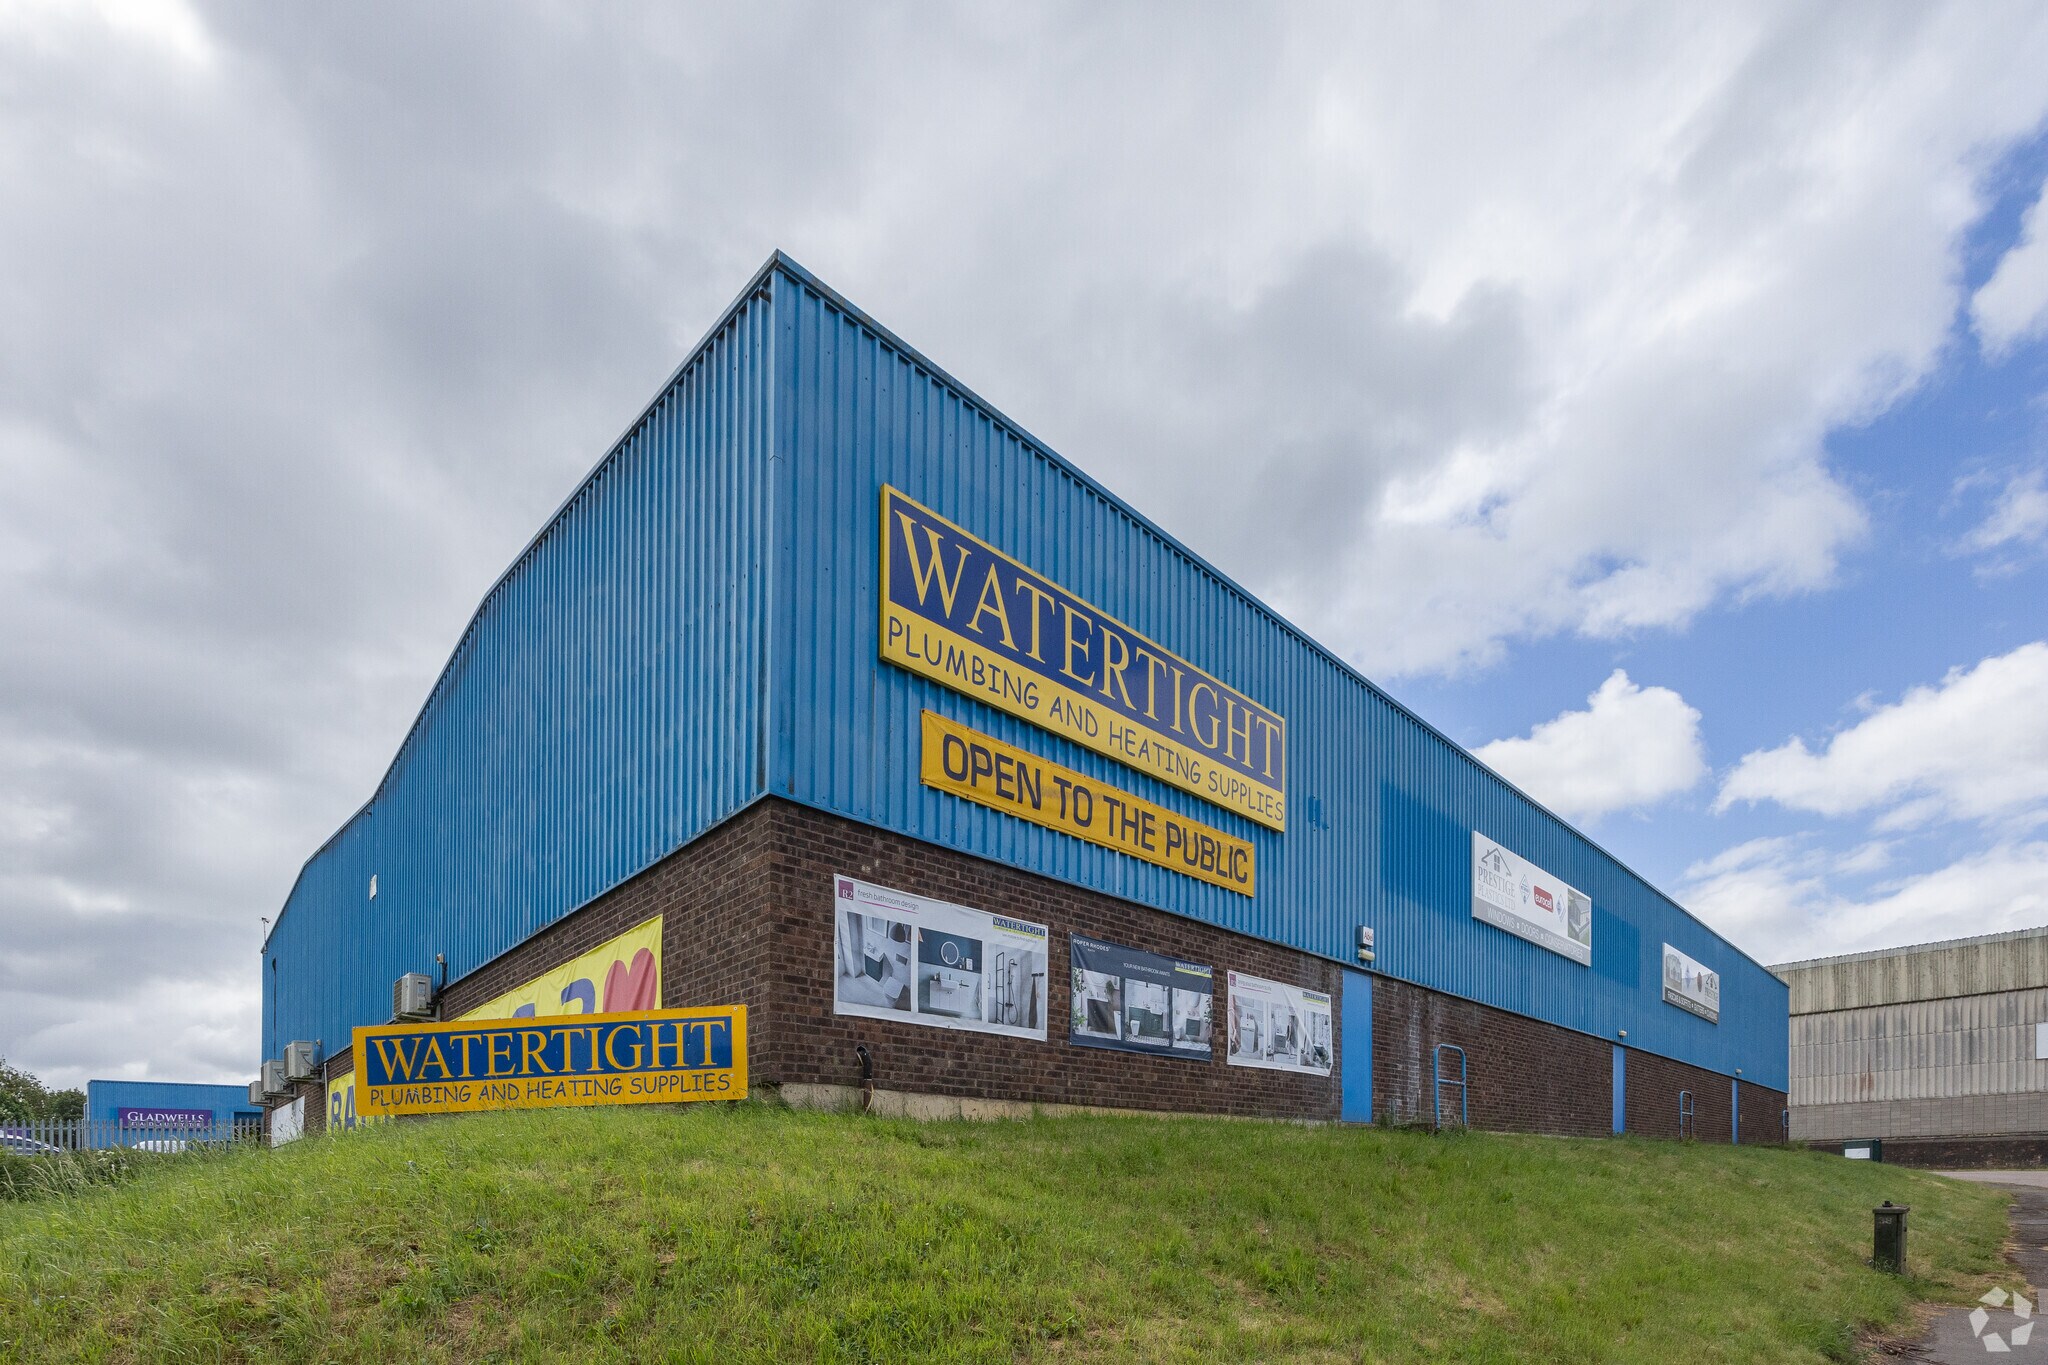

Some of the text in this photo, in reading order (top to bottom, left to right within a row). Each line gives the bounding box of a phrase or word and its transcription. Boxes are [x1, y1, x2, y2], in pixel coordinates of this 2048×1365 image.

[894, 509, 1280, 780] WATERTIGHT
[888, 615, 1284, 822] PLUMBING AND HEATING SUPPLIES
[942, 733, 1249, 884] OPEN TO THE PUBLIC
[1478, 866, 1515, 898] PRESTIGE
[857, 888, 873, 900] fresh
[873, 893, 901, 907] bathroom
[901, 900, 920, 911] design
[1535, 894, 1553, 909] eurocell
[993, 917, 1046, 937] WATERTIGHT
[1487, 907, 1515, 929] WINDOWS
[1521, 922, 1540, 940] DOORS
[1175, 961, 1212, 976] WATERTIGHT
[371, 1019, 727, 1083] WATERTIGHT
[369, 1072, 731, 1107] PLUMBING AND HEATING SUPPLIES
[127, 1111, 205, 1123] GLADWELLS
